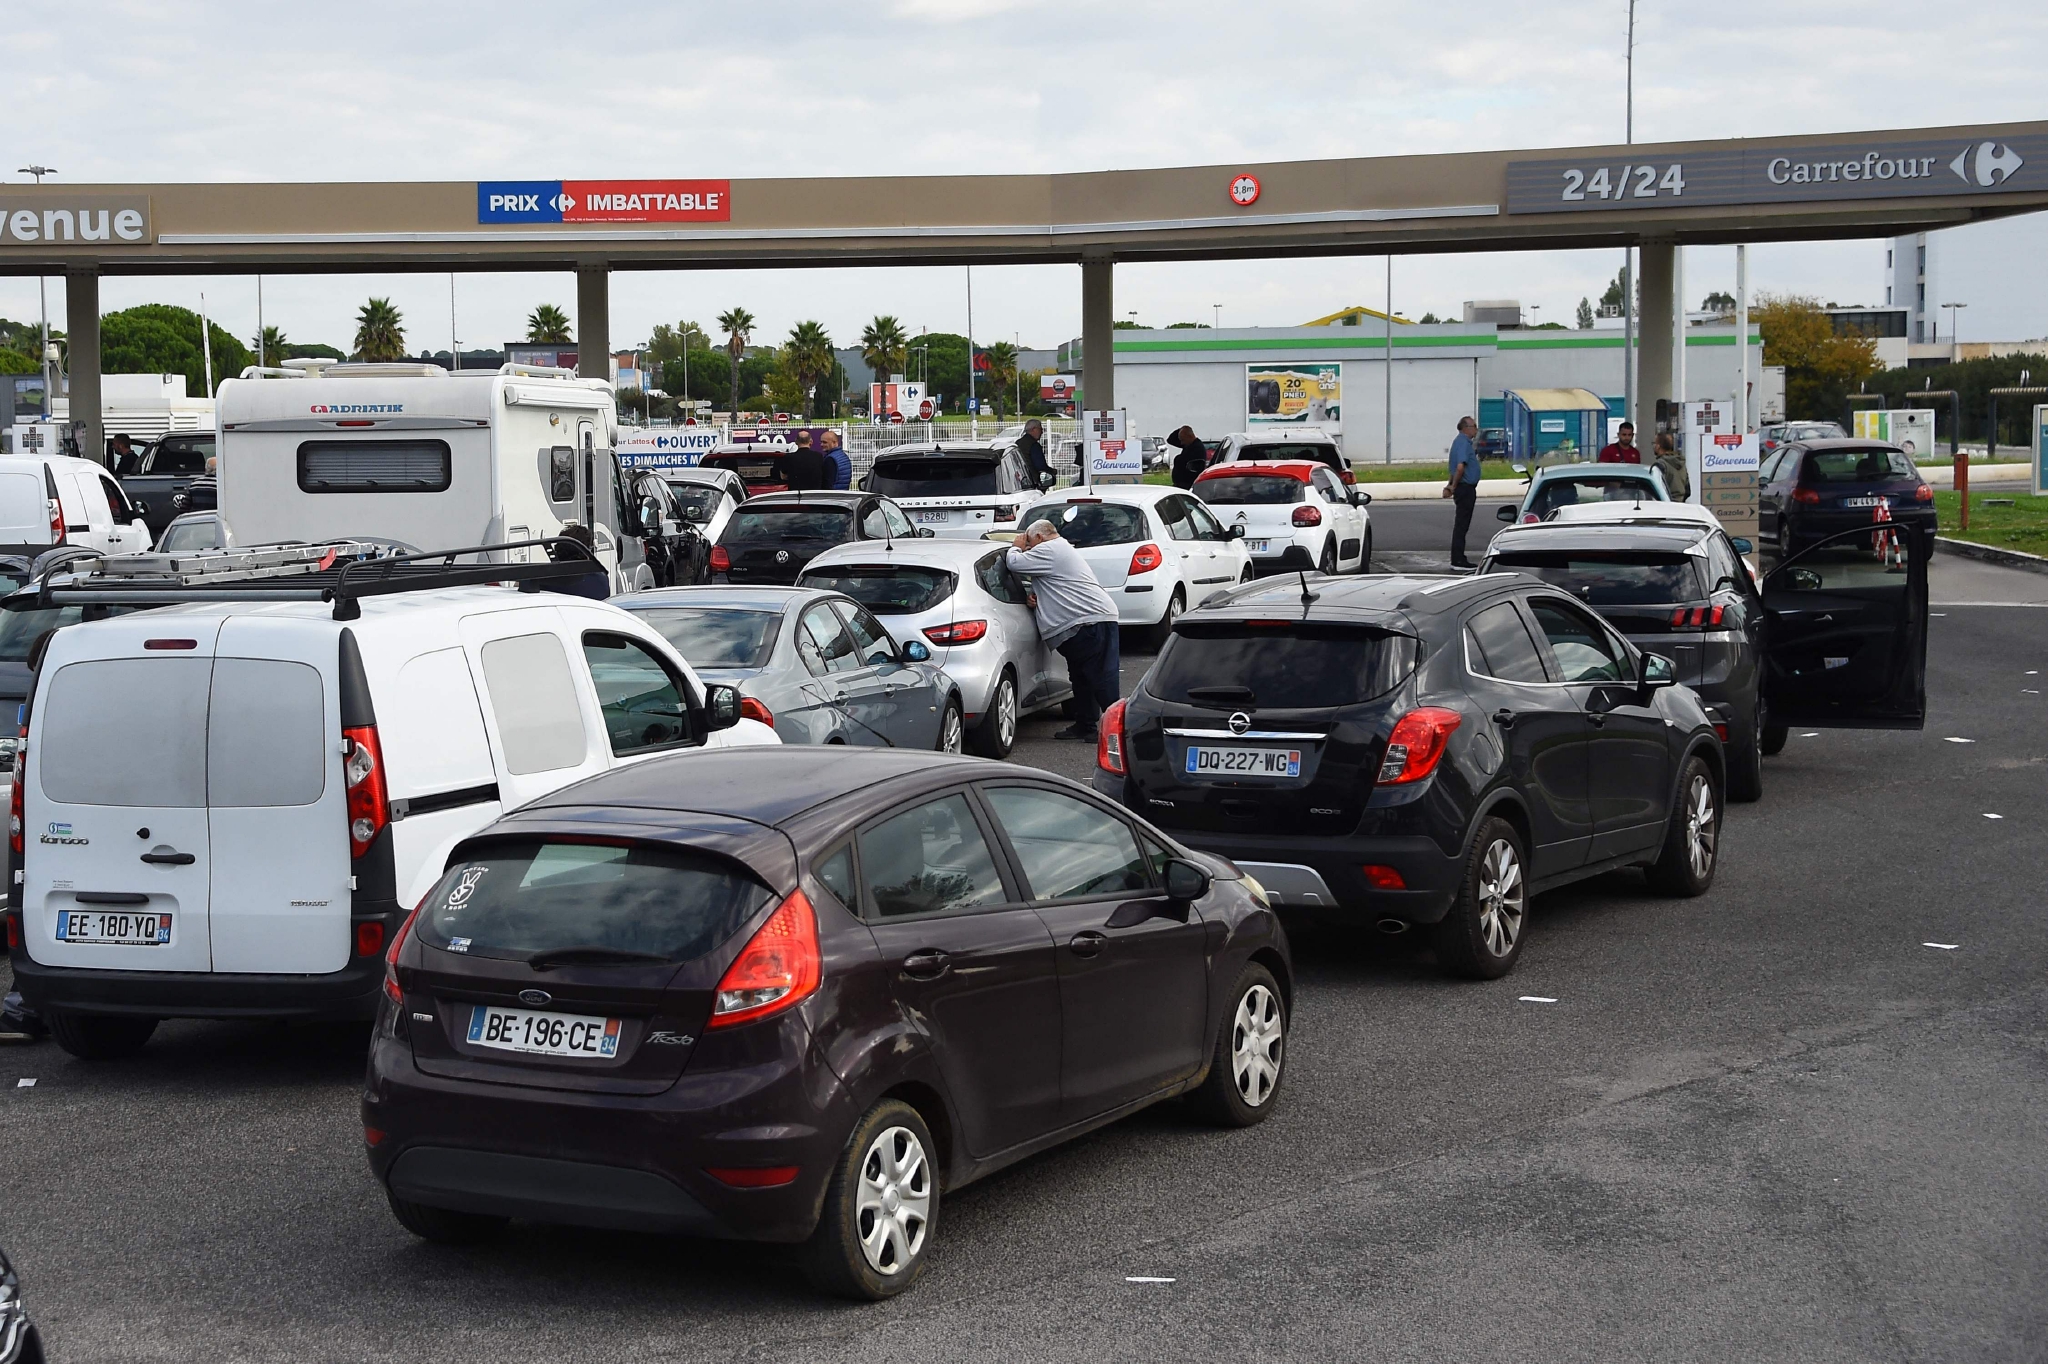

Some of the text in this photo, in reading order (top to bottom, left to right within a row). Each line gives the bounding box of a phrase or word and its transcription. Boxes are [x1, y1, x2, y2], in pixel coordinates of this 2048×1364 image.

[1767, 152, 1937, 185] Carrefour
[1562, 164, 1686, 201] 24/24
[1234, 186, 1254, 195] 3,8m
[490, 194, 540, 212] PRIX
[0, 209, 144, 241] enue
[920, 406, 932, 414] STOP
[670, 435, 718, 449] OUVERT
[634, 453, 688, 467] DIMANCHES
[1092, 459, 1141, 470] Bienvenue
[1703, 454, 1758, 467] Bienvenue
[924, 512, 947, 521] 628U
[1716, 509, 1745, 517] Gazole
[1198, 750, 1288, 772] DQ-227-WG
[602, 1036, 615, 1051] 34
